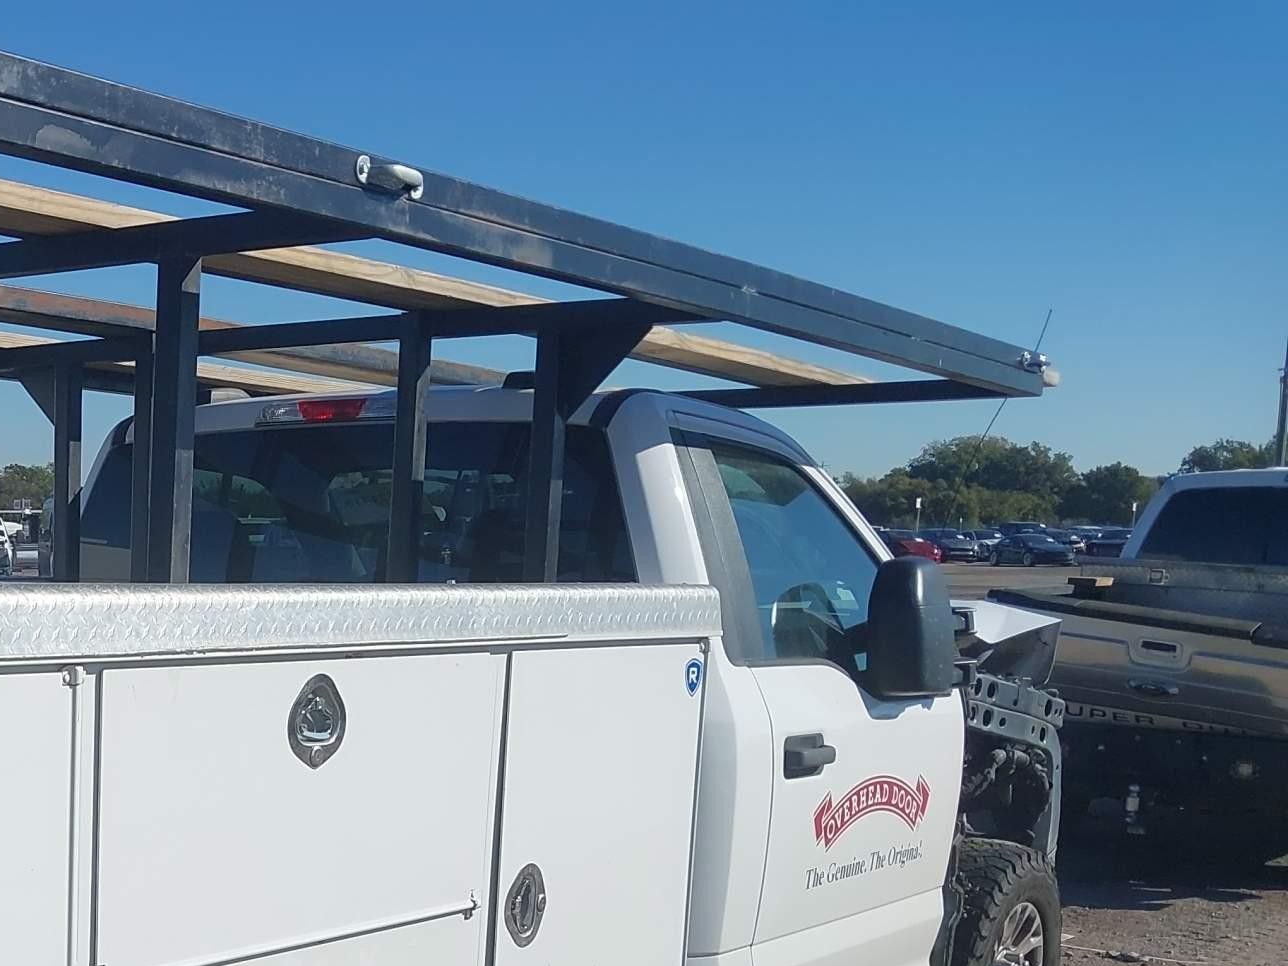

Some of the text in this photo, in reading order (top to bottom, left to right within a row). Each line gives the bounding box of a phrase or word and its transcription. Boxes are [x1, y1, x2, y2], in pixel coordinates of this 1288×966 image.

[1064, 704, 1155, 726] UPER
[826, 783, 918, 839] OVERHEAD DOOR
[805, 868, 825, 890] The
[826, 857, 867, 884] Genuine.
[869, 851, 886, 872] The
